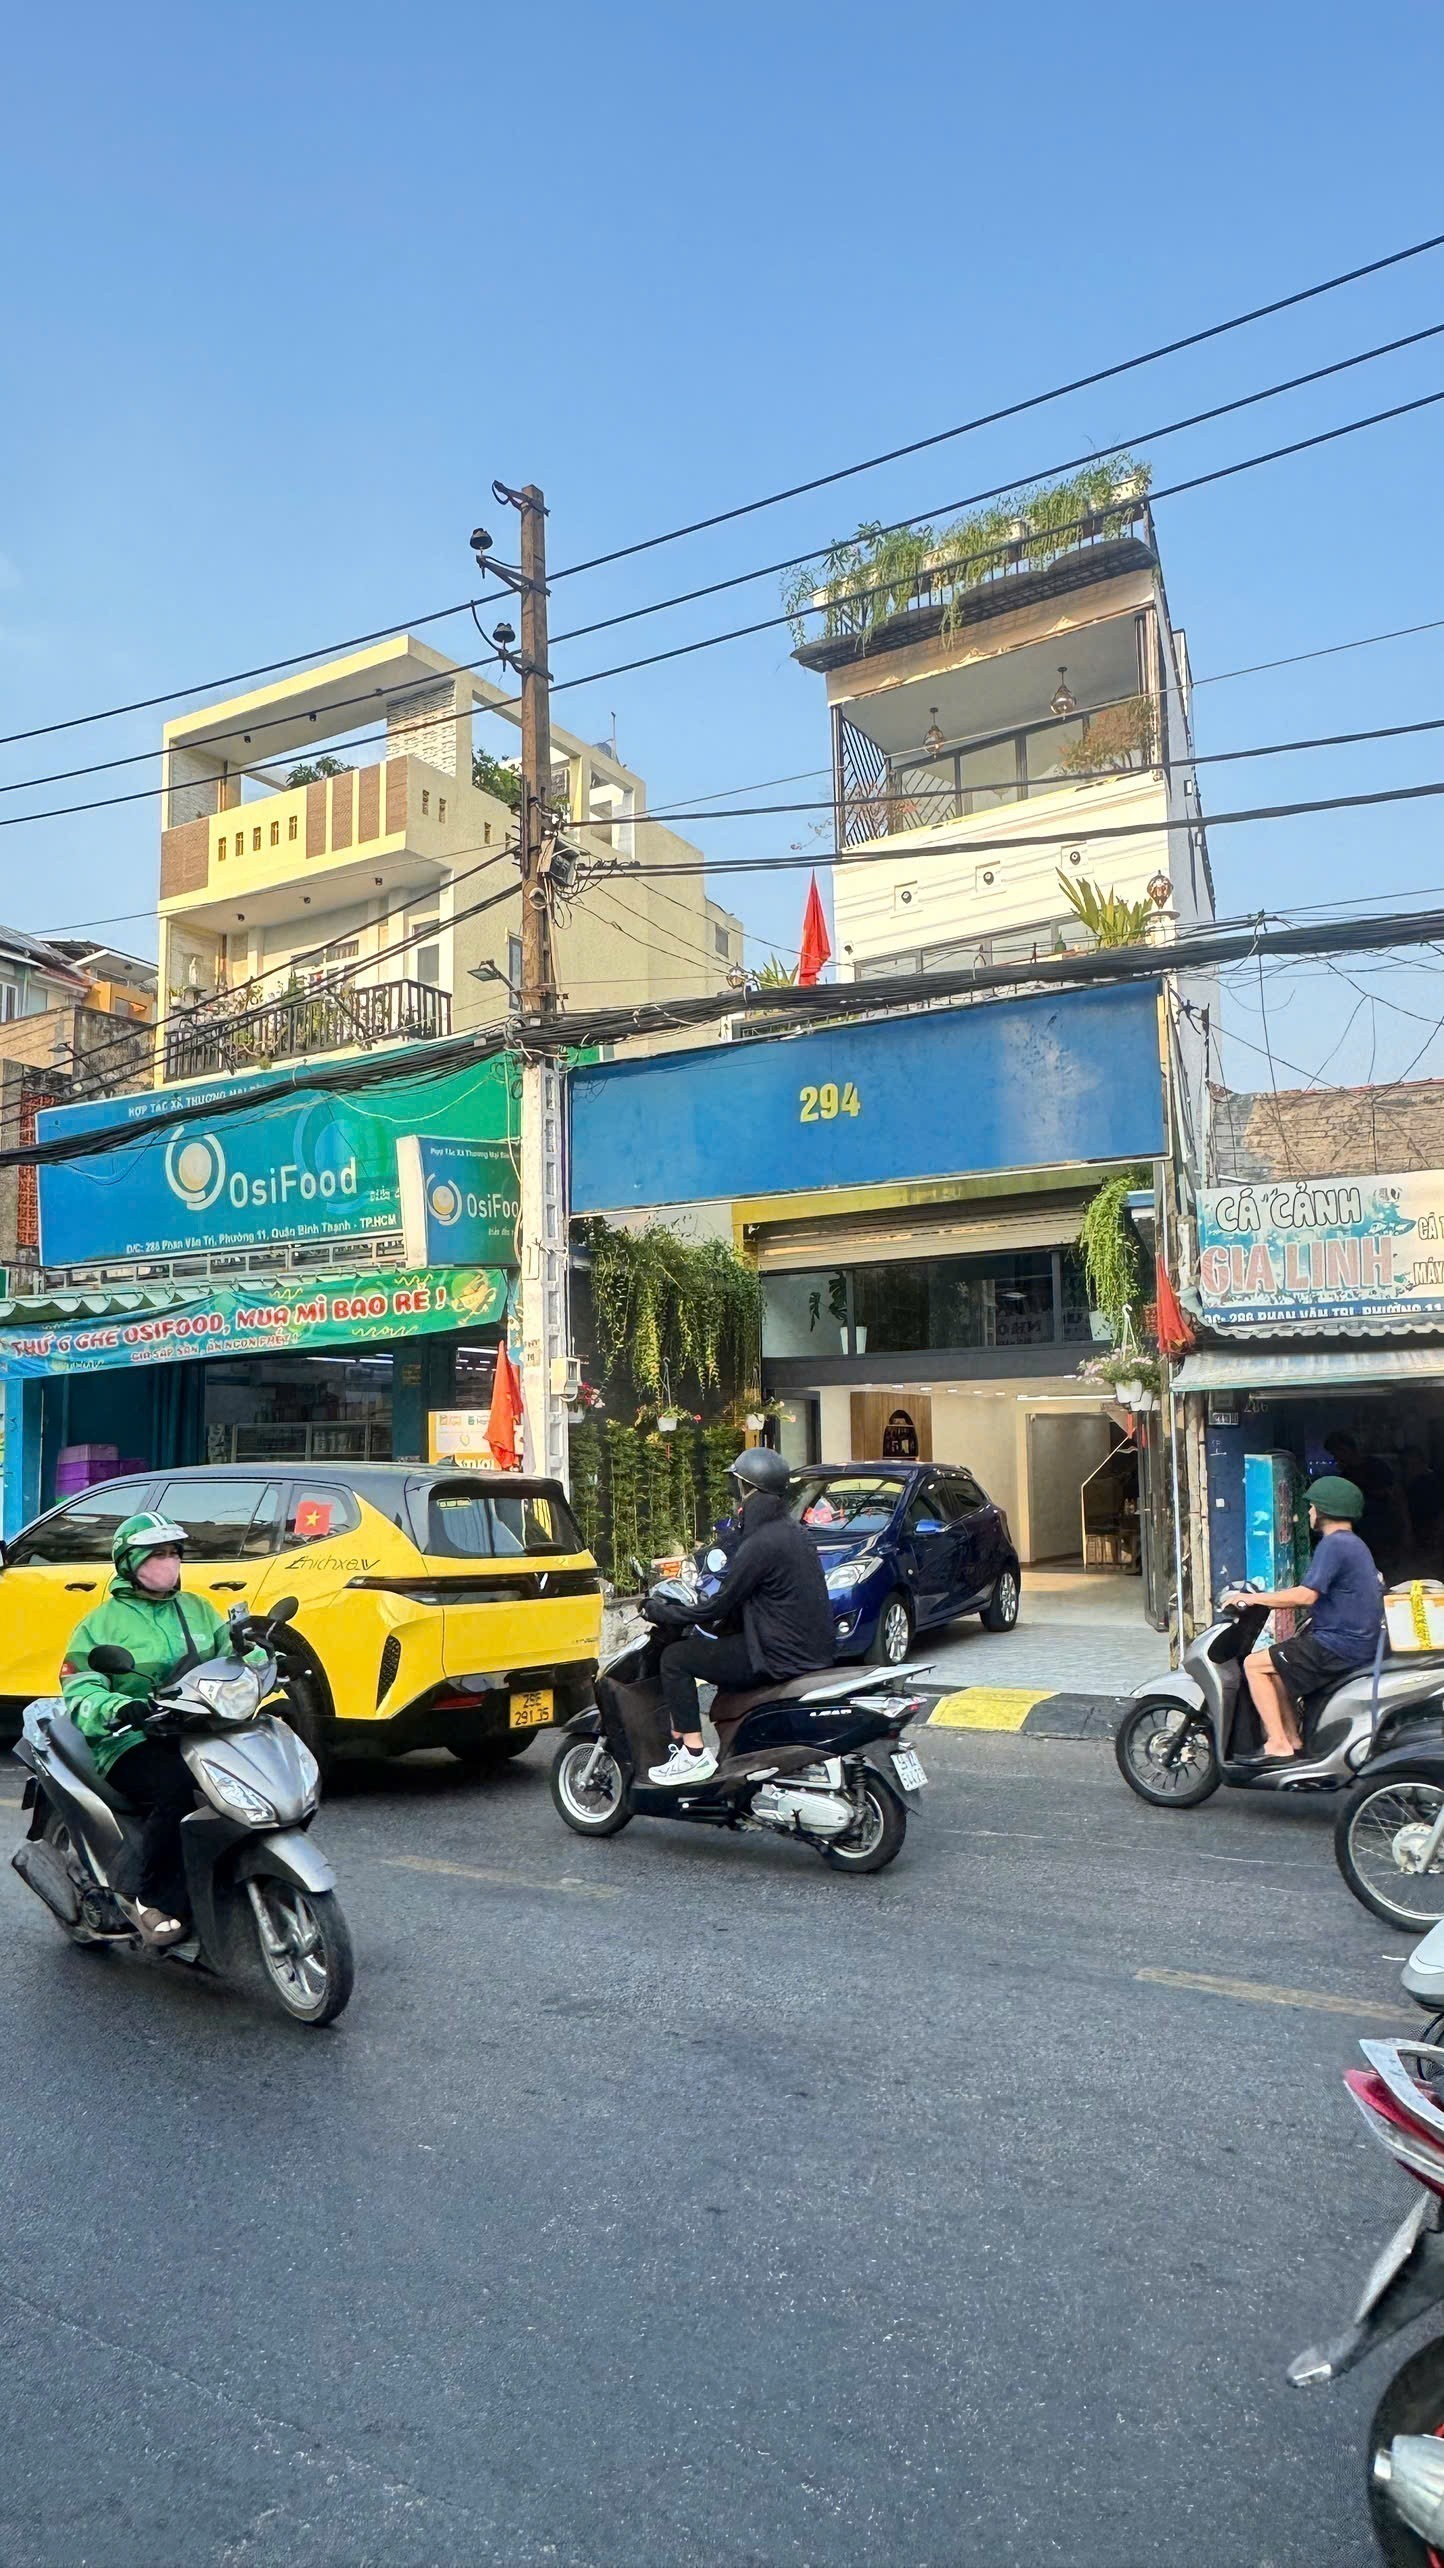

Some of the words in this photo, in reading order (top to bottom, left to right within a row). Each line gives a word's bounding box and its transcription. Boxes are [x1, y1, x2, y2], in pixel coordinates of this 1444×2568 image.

[800, 1082, 860, 1122] 294
[230, 1156, 357, 1208] OsiFood
[467, 1192, 519, 1219] OsiFoo
[1216, 1188, 1260, 1232] CÁ
[1270, 1181, 1362, 1230] CẢNH
[1200, 1243, 1277, 1295] GIA
[1285, 1236, 1393, 1293] LINH
[57, 1334, 72, 1353] 6
[235, 1305, 291, 1330] MUA
[294, 1293, 327, 1325] MÌ
[332, 1294, 387, 1321] BAO
